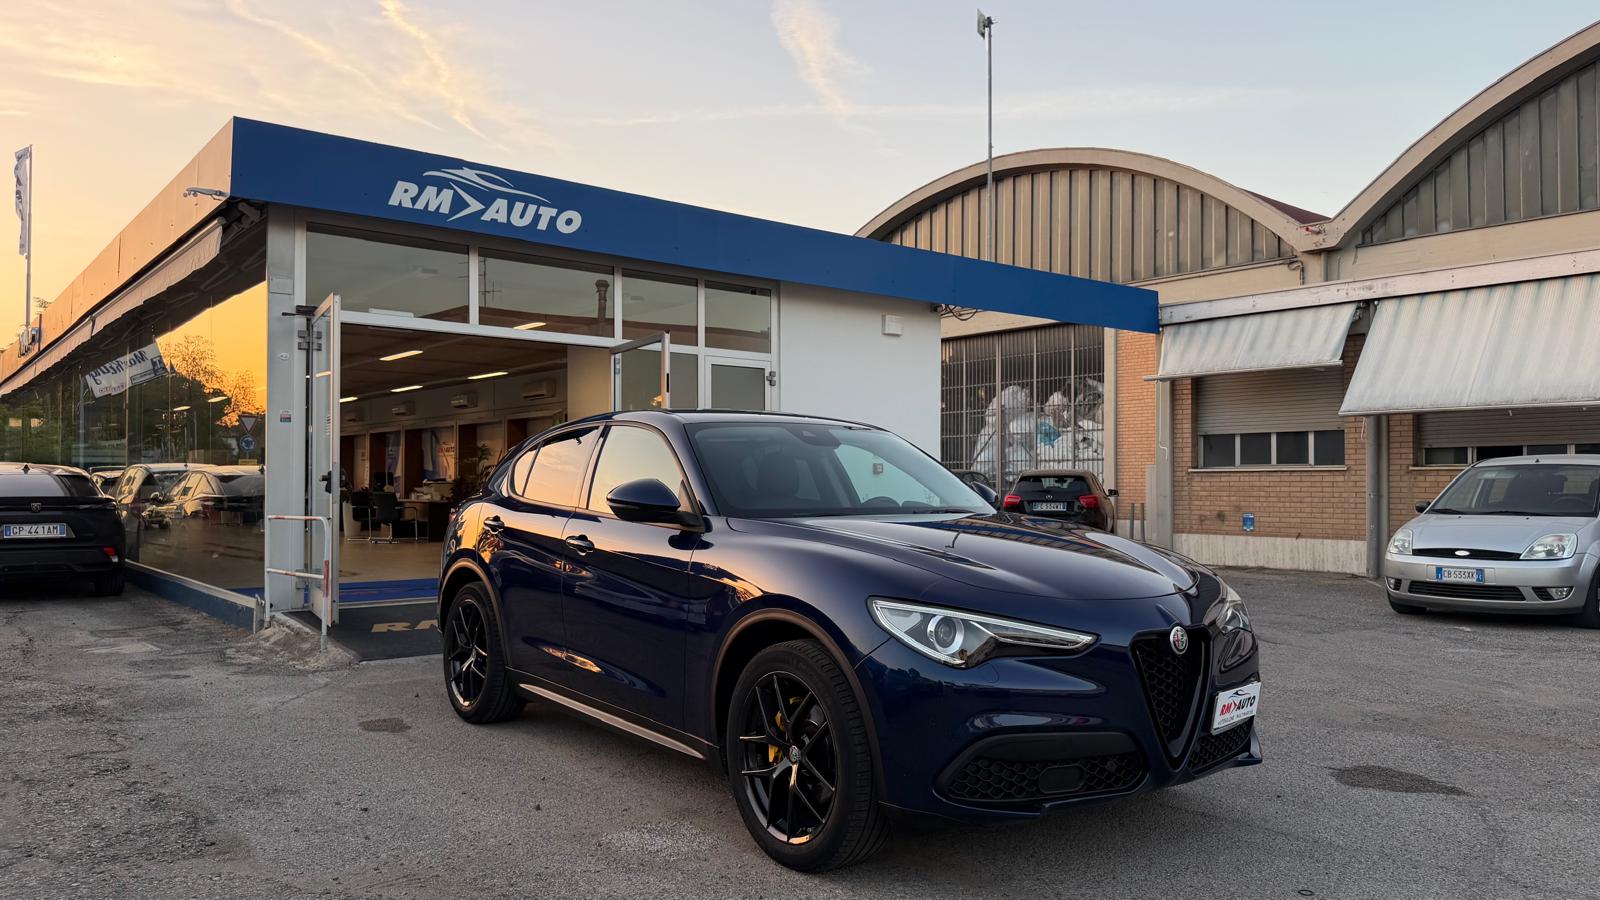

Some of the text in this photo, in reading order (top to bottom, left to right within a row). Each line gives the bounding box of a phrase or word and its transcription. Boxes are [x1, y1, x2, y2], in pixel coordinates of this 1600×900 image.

[387, 180, 582, 234] RM AUTO
[27, 525, 58, 535] 441AM
[1220, 695, 1256, 716] RM AUTO
